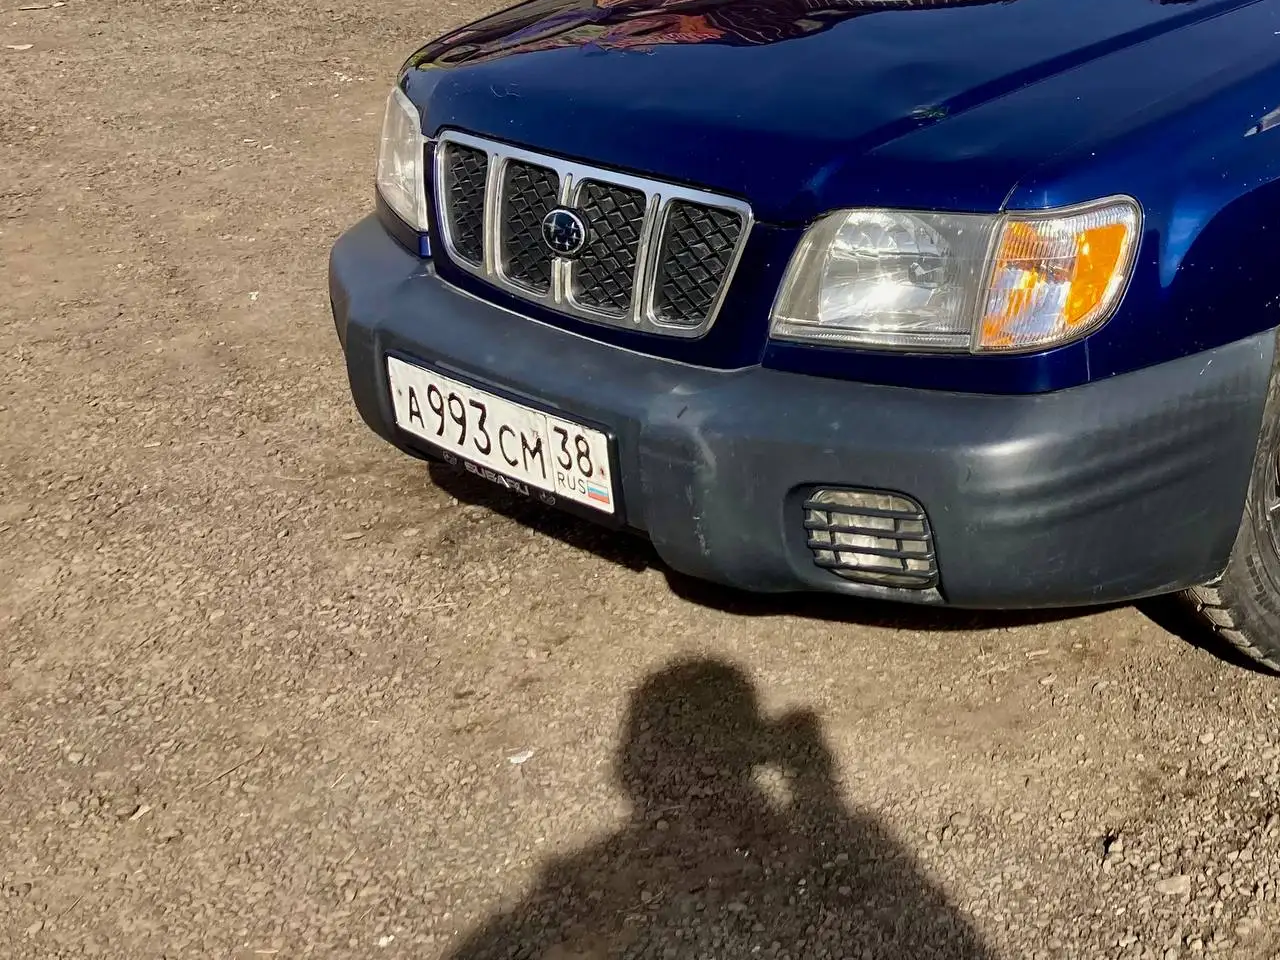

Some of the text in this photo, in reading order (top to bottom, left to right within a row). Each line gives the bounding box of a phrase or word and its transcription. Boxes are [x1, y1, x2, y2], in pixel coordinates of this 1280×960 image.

[553, 426, 593, 477] 38
[464, 461, 530, 496] SUBARU
[557, 472, 586, 495] RUS
